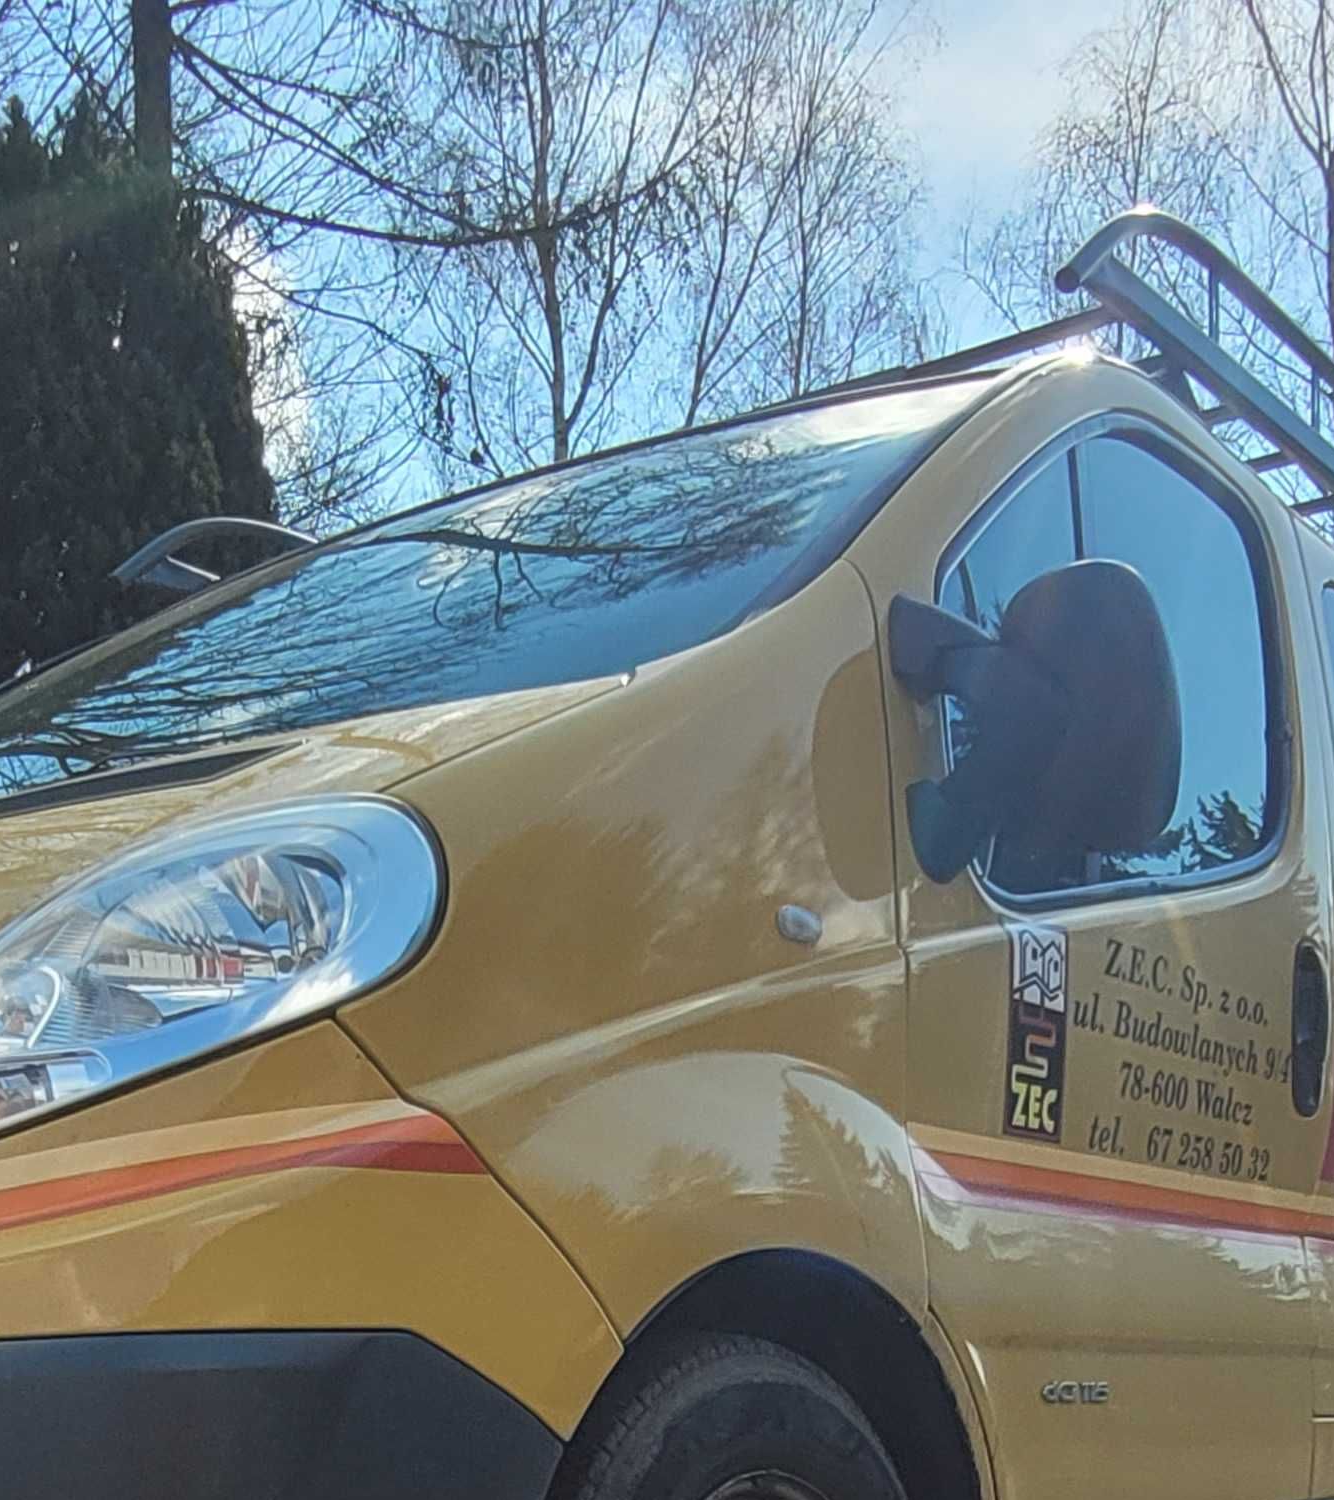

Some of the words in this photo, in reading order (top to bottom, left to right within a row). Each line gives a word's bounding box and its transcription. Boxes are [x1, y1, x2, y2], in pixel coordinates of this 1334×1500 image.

[1104, 938, 1173, 996] Z.E.C.
[1180, 968, 1212, 1012] Sp.
[1236, 999, 1269, 1028] o.o.
[1073, 993, 1105, 1034] ul.
[1113, 1001, 1258, 1076] Budowlanych
[1011, 1080, 1059, 1134] ZEC
[1119, 1061, 1189, 1112] 78-600
[1088, 1116, 1125, 1157] tel.
[1146, 1125, 1174, 1163] 67
[1177, 1132, 1215, 1172] 258
[1218, 1141, 1244, 1178] 50
[1246, 1147, 1271, 1182] 32
